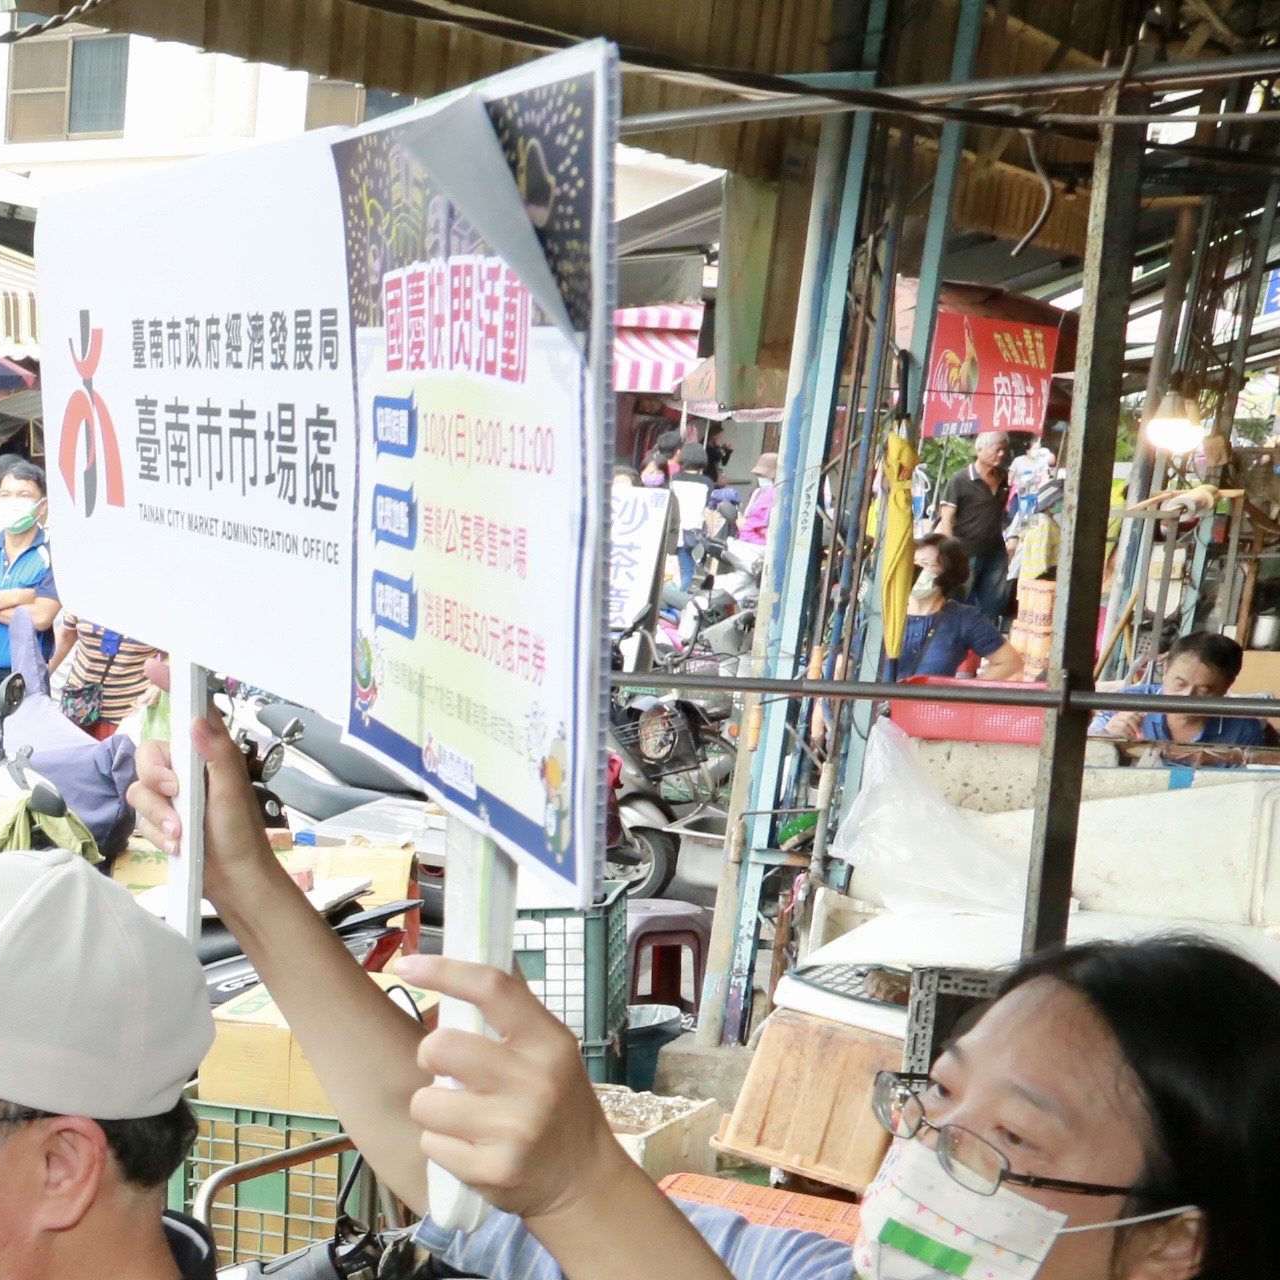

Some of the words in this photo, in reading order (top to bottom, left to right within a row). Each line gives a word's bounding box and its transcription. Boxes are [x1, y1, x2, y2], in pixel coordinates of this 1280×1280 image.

[131, 308, 339, 370] 臺南市政府經濟發展局
[135, 395, 340, 511] 臺南市市場處
[139, 503, 165, 526] TAINAN
[167, 508, 185, 530] CITY
[187, 512, 219, 537] MARKET
[221, 519, 298, 556] ADMINISTRATION
[302, 536, 339, 566] OFFICE
